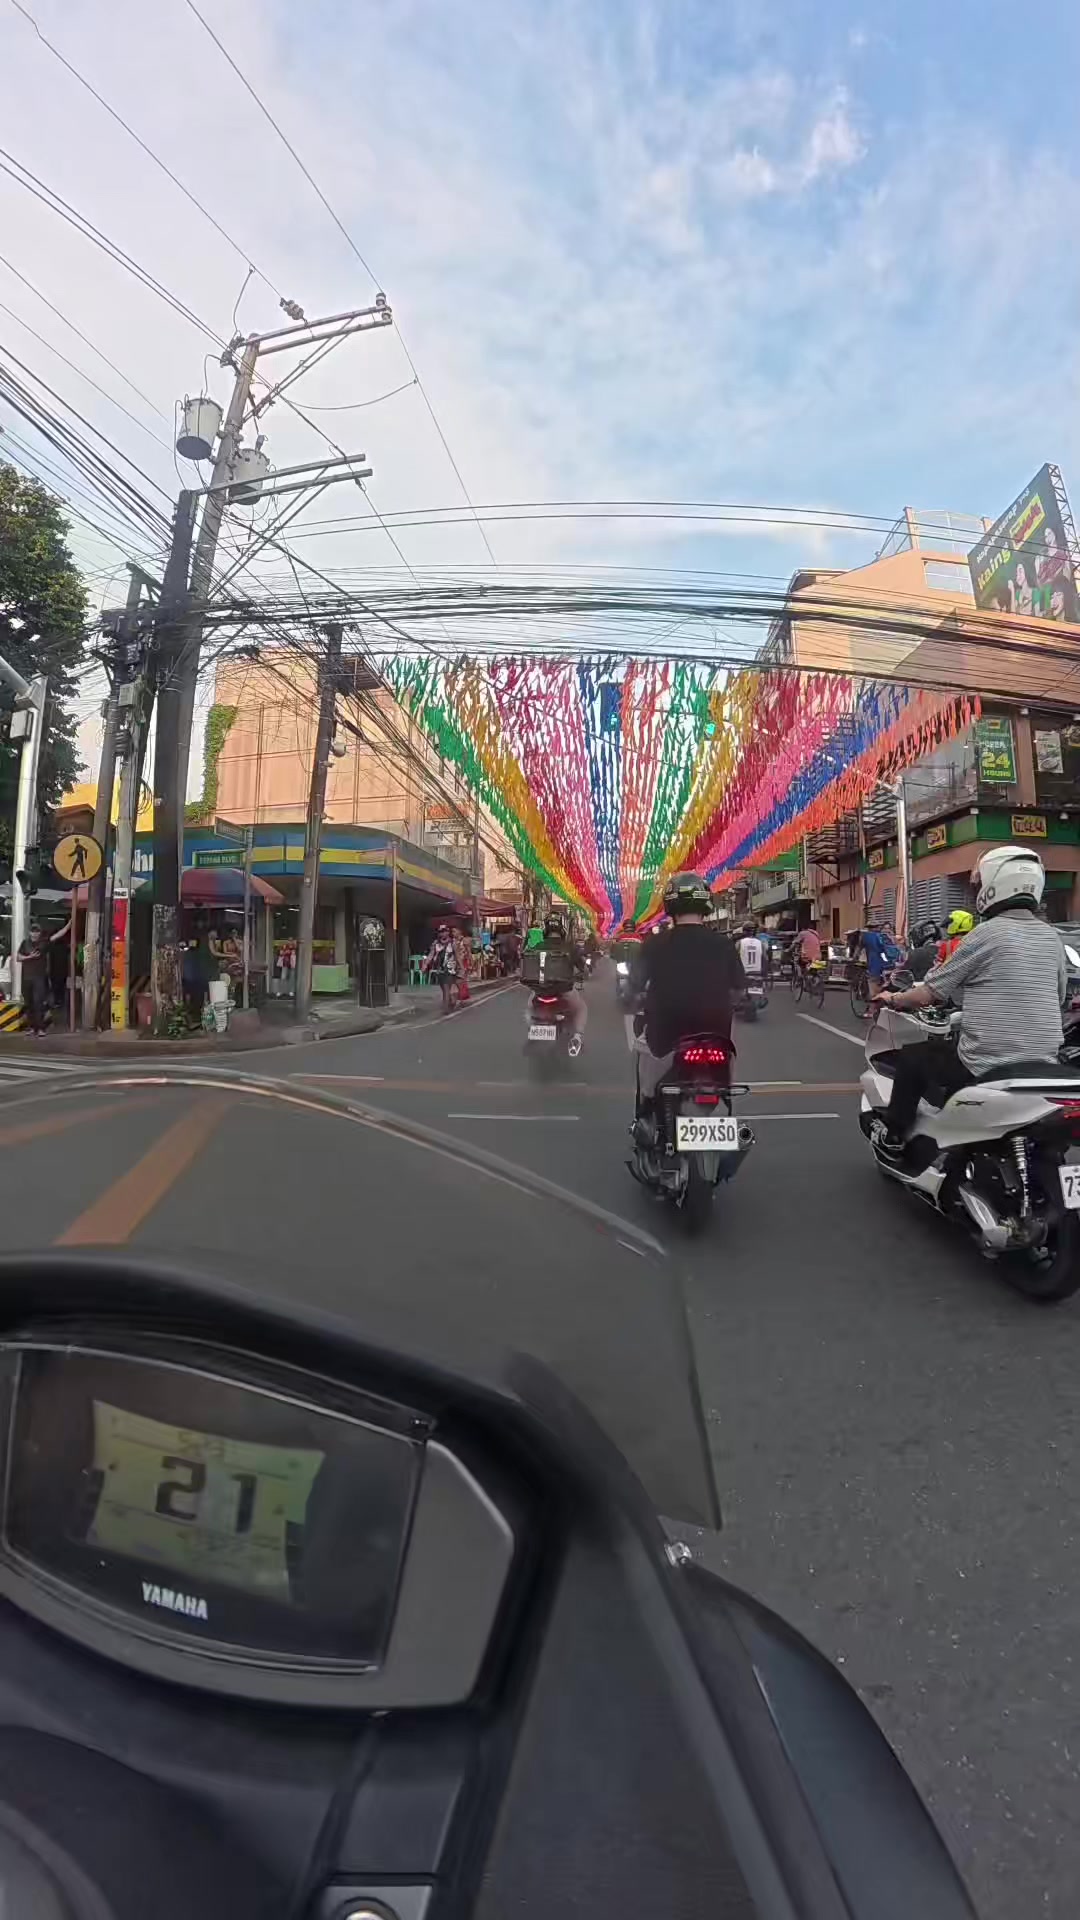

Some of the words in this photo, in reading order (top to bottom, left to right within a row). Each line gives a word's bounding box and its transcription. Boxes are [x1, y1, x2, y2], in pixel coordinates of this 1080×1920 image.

[982, 751, 1010, 768] 24
[155, 1455, 257, 1535] 21
[141, 1581, 209, 1621] YAMAHA
